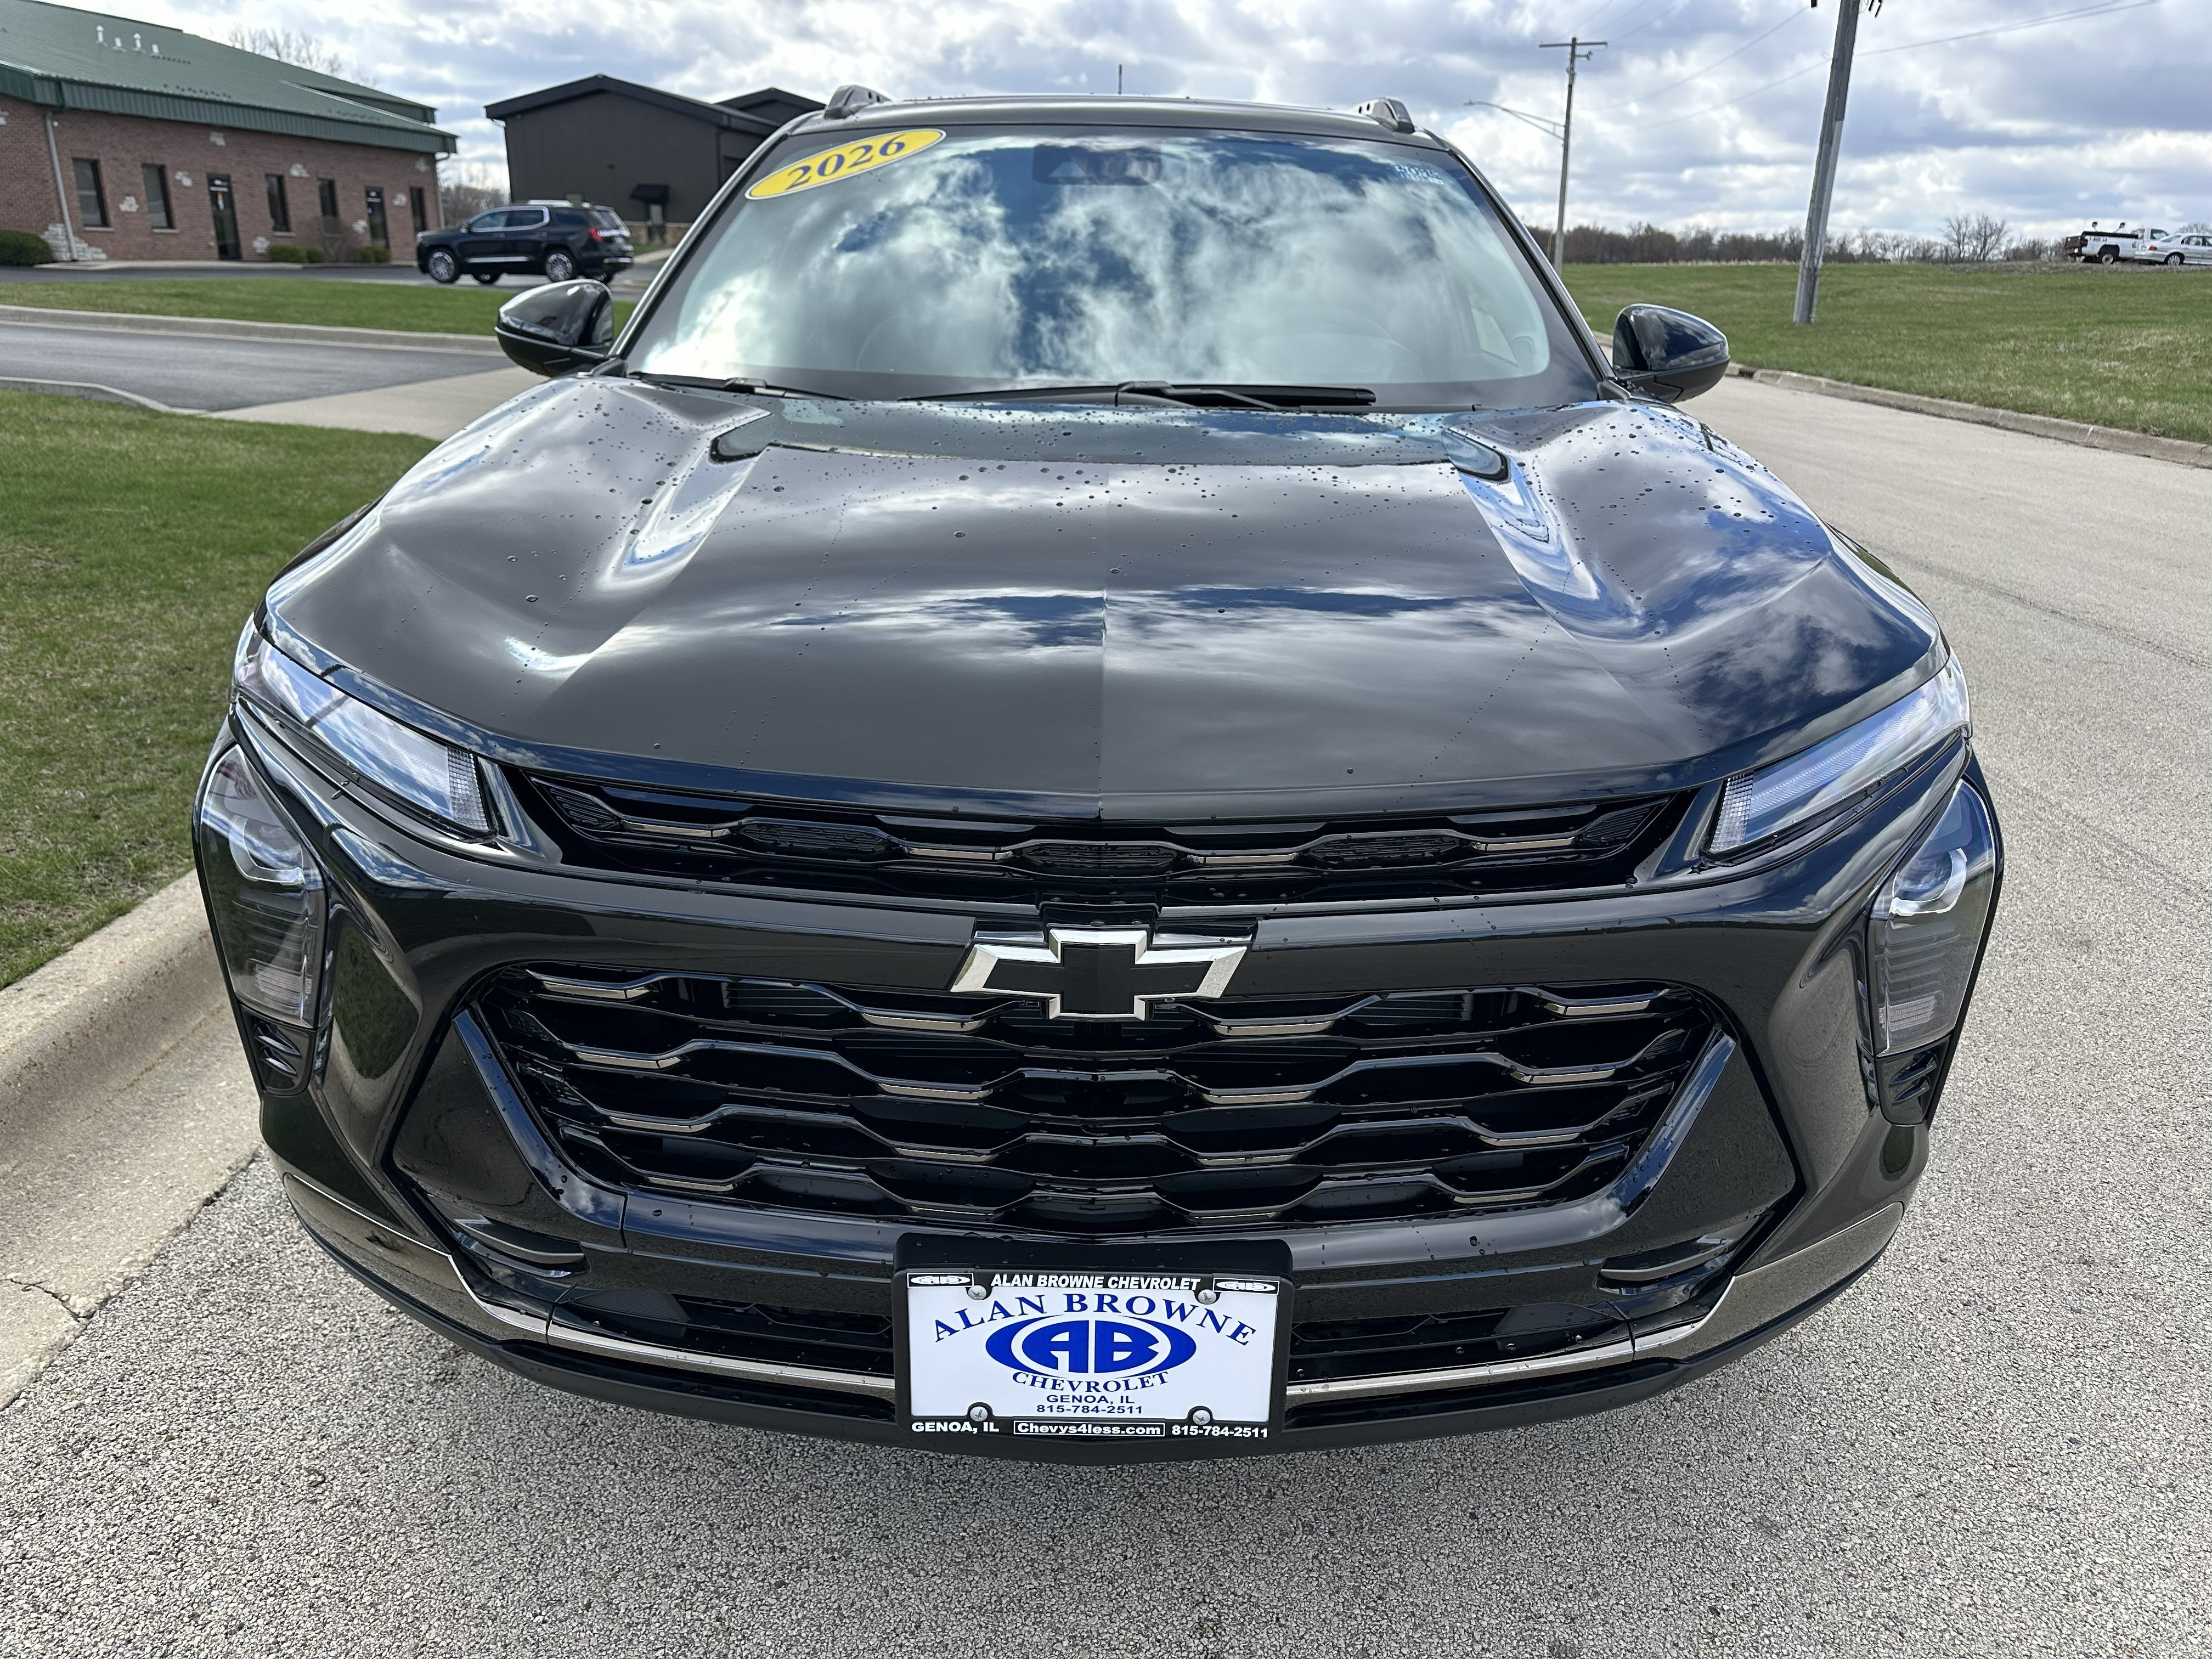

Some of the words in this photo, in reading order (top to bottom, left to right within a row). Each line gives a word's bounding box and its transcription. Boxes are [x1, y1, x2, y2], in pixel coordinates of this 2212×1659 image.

[784, 133, 906, 190] 2026
[991, 1274, 1034, 1287] ALAN
[1037, 1275, 1104, 1289] BROWNE
[1108, 1276, 1201, 1290] CHEVROLET
[935, 1294, 1047, 1342] ALAN
[1063, 1293, 1256, 1346] BROWNE
[1022, 1319, 1159, 1374] AB
[1012, 1371, 1169, 1392] CHEVROLET
[1046, 1395, 1113, 1404] GENOA,
[1120, 1395, 1135, 1403] IL
[1036, 1404, 1142, 1414] 815-784-2511
[911, 1421, 978, 1434] GENOA,
[983, 1422, 1000, 1432] IL
[1017, 1423, 1161, 1435] Chevys4less.com
[1171, 1425, 1268, 1438] 815-784-2511
